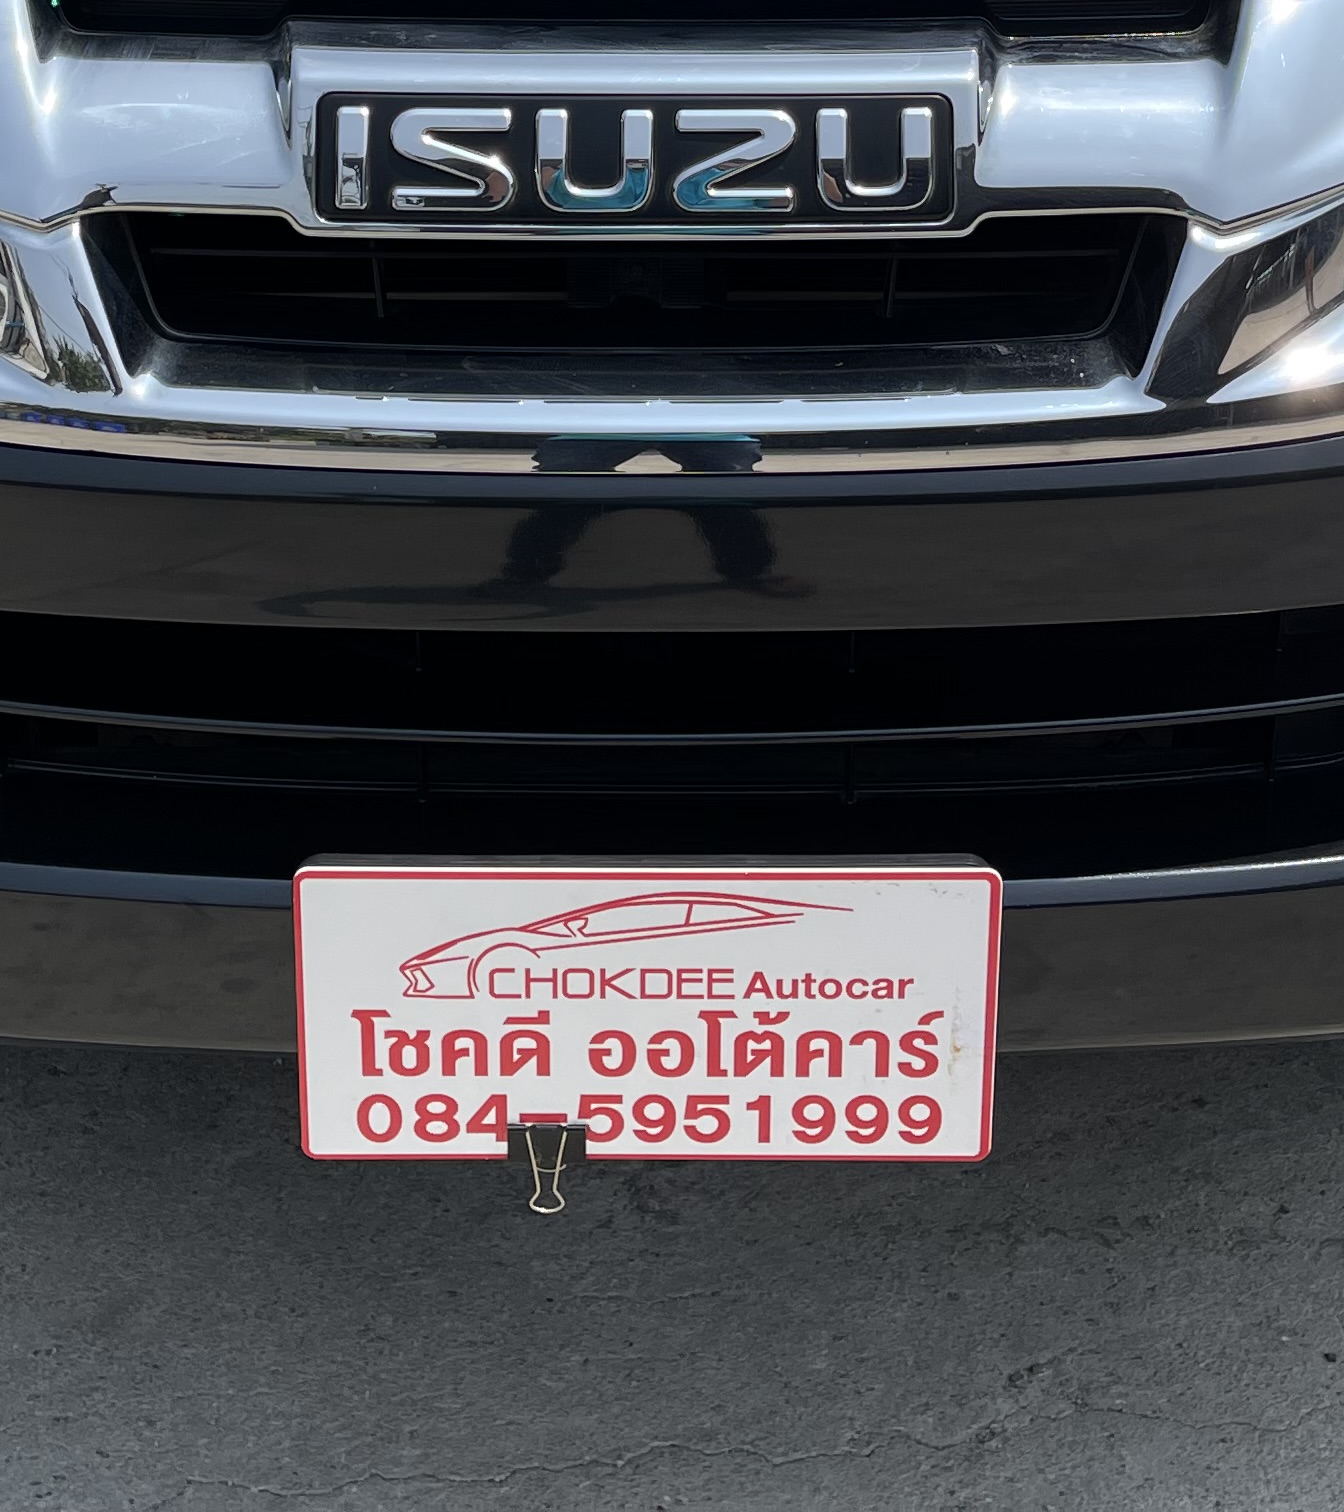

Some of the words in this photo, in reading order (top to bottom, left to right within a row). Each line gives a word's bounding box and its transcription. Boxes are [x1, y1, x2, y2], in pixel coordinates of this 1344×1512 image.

[335, 106, 933, 212] ISUZU
[488, 968, 735, 999] CHOKDEE
[743, 971, 914, 1000] Autocar
[352, 1010, 551, 1077] โชคดี
[588, 1010, 944, 1078] ออโต้คาร์
[357, 1094, 942, 1144] 084-5951999
